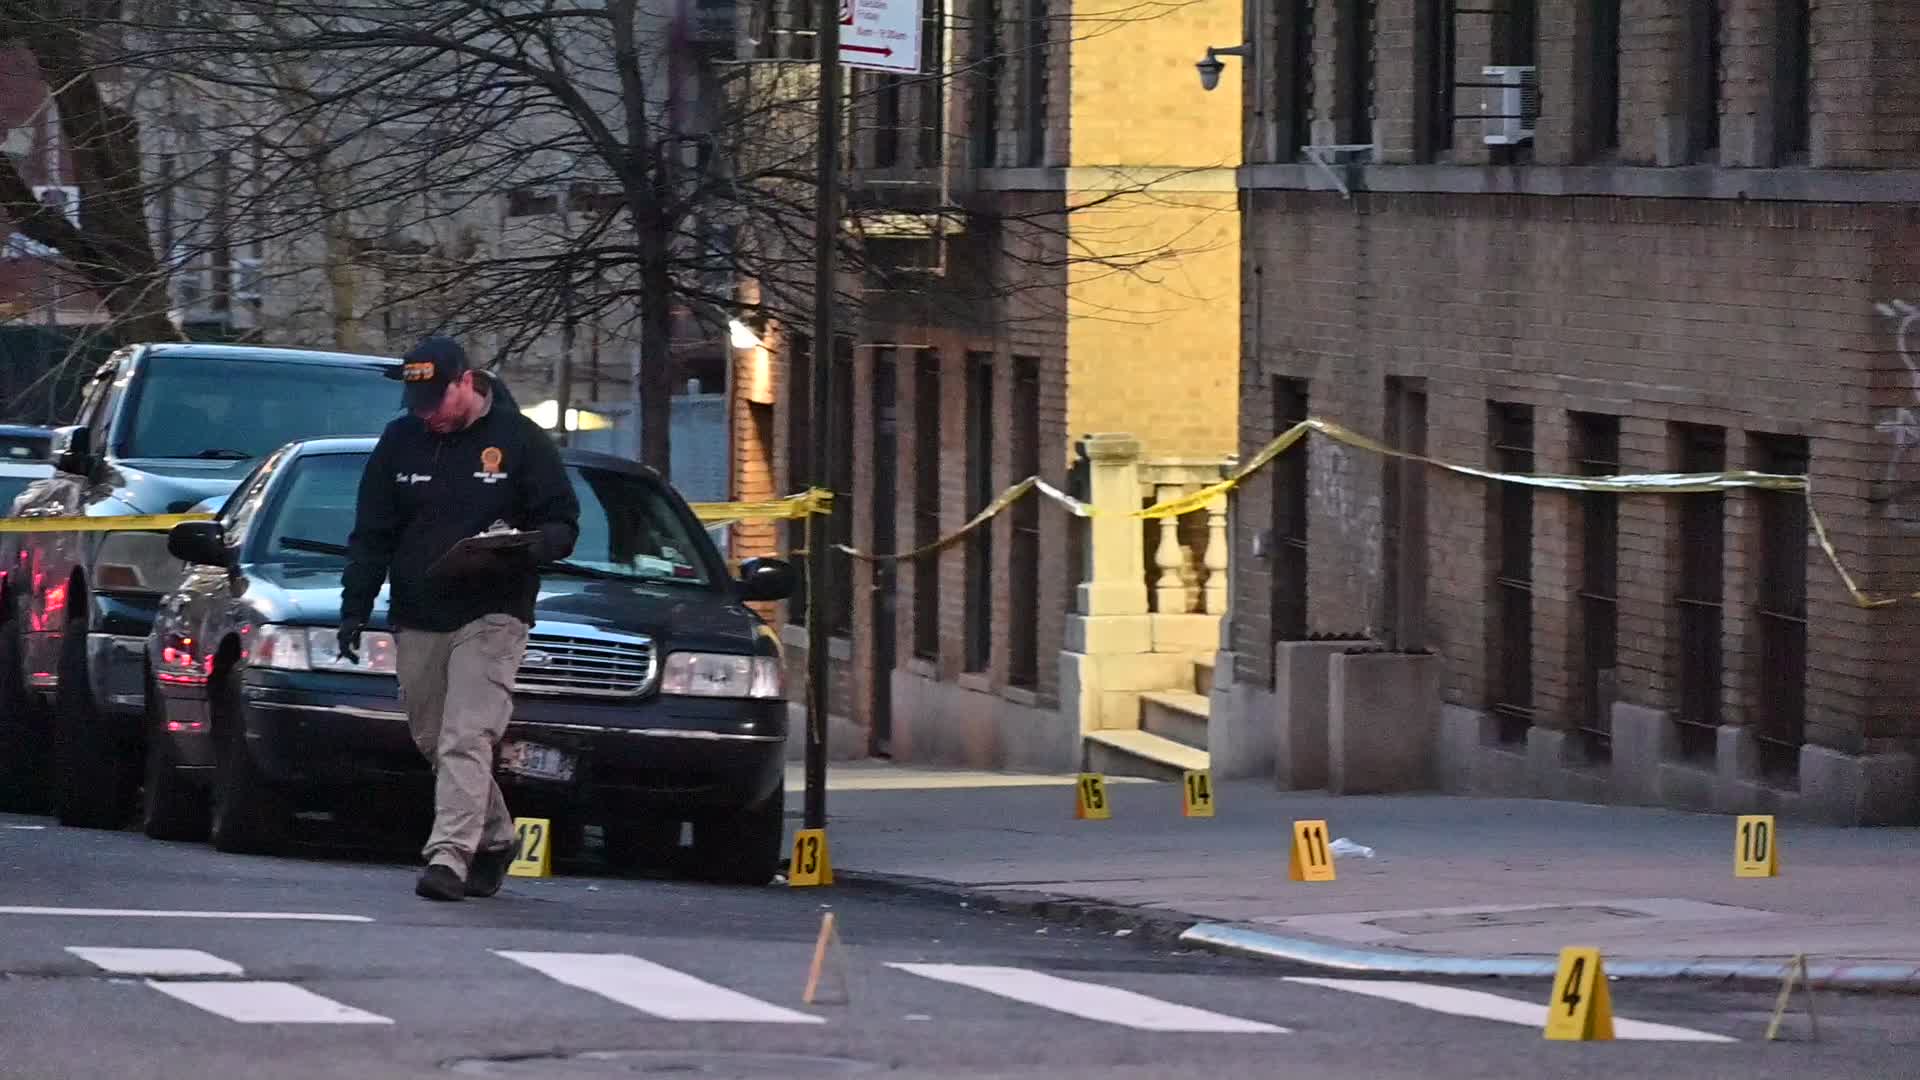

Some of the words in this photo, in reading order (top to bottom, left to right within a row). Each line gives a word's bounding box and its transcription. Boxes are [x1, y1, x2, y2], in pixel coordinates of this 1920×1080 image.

[1082, 778, 1102, 808] 15
[1188, 775, 1210, 805] 14
[519, 824, 542, 862] 12
[796, 837, 818, 874] 13
[1303, 826, 1327, 866] 11
[1743, 822, 1766, 862] 10
[1562, 957, 1584, 1016] 4
